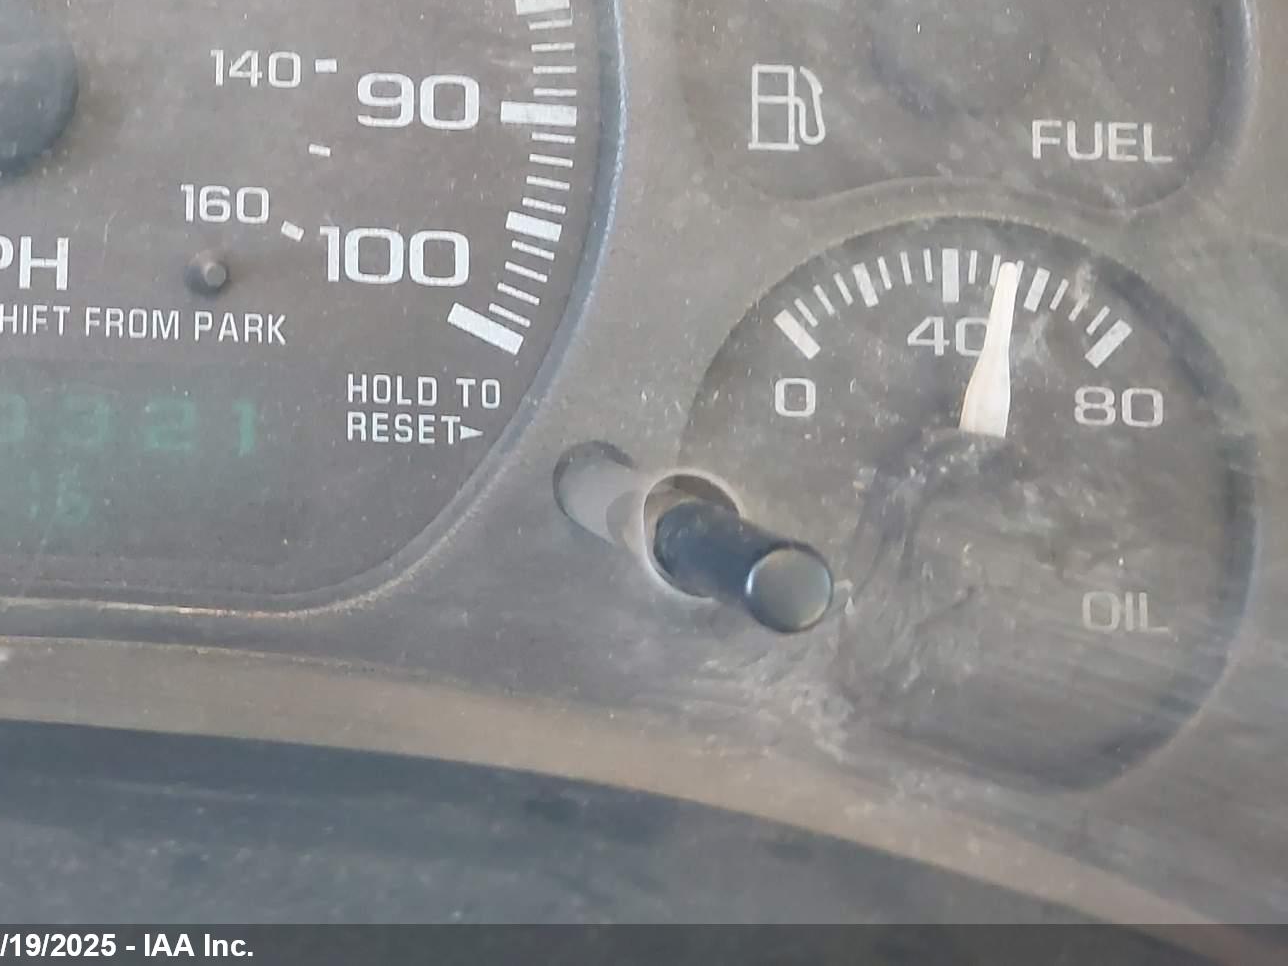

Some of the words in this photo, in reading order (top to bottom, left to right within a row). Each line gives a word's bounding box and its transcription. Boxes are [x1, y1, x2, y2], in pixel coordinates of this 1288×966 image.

[210, 49, 301, 89] 140
[357, 72, 481, 131] 90
[1031, 118, 1174, 163] FUEL
[180, 184, 270, 225] 160
[319, 225, 471, 287] 100
[85, 306, 180, 341] FROM
[194, 311, 287, 346] PARK
[906, 315, 989, 358] 40
[346, 373, 438, 407] HOLD
[455, 377, 501, 410] TO
[773, 377, 817, 417] 0
[1073, 385, 1165, 428] 80
[61, 392, 113, 450] 3
[142, 399, 198, 452] 2
[231, 398, 259, 456] 1
[346, 411, 461, 445] RESET
[1081, 591, 1169, 634] OIL
